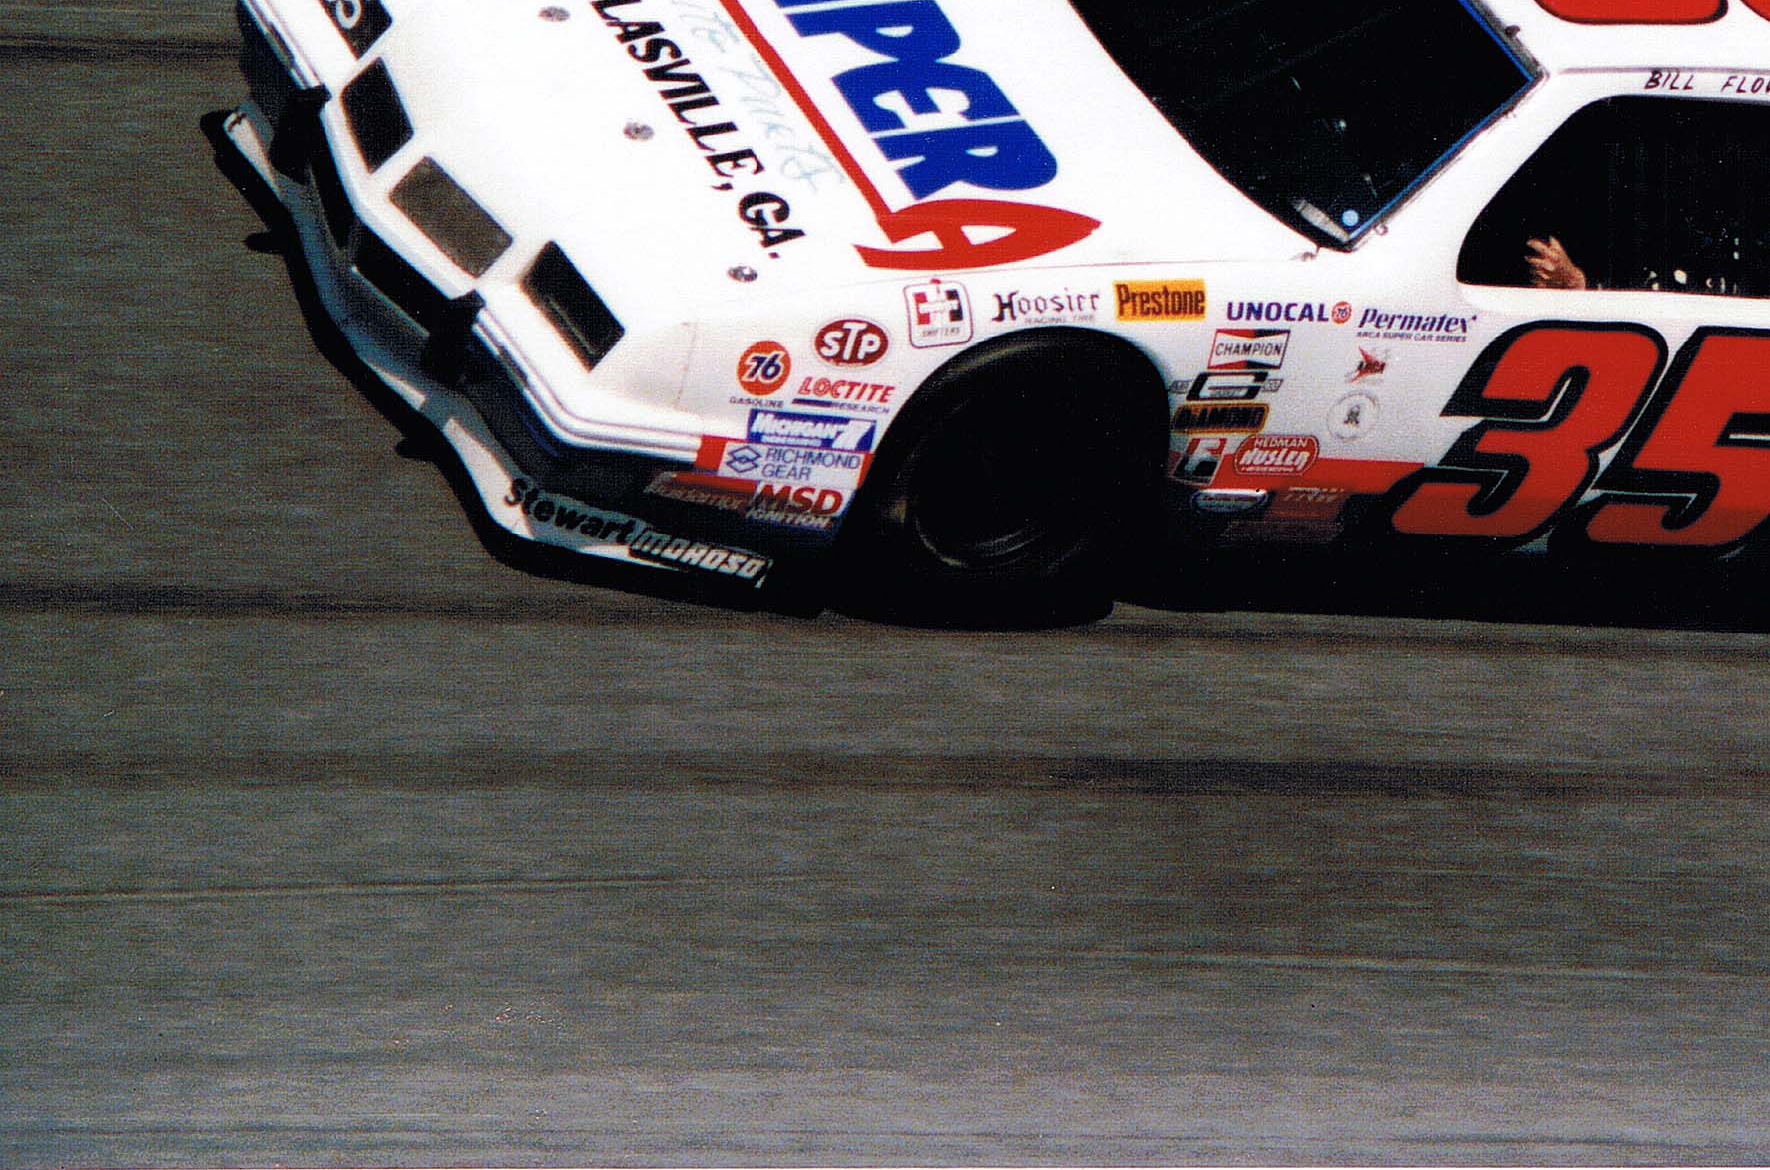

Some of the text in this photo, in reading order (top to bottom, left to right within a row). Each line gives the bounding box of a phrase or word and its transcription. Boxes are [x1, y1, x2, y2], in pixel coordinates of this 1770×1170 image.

[1643, 69, 1695, 91] BILL
[738, 191, 807, 260] GA.
[991, 287, 1100, 322] Hoosier
[1115, 283, 1206, 317] Prestone
[1226, 301, 1330, 323] UNOCAL
[1358, 307, 1477, 334] Permatex
[818, 321, 882, 362] STP
[1215, 342, 1283, 356] CHAMPION
[1356, 331, 1467, 343] ARCA SUPER CAR SERIES
[740, 350, 787, 383] 76
[796, 376, 896, 404] LOCTITE
[728, 396, 785, 409] GASOLINE
[829, 401, 891, 415] RESEARCH
[1254, 437, 1308, 448] HEDMAN
[764, 446, 862, 470] RICHMOND
[1239, 447, 1311, 471] HUSLER
[761, 462, 812, 481] GEAR
[754, 483, 844, 516] MSD
[503, 478, 635, 546] Stewart
[747, 509, 833, 530] IGNITION
